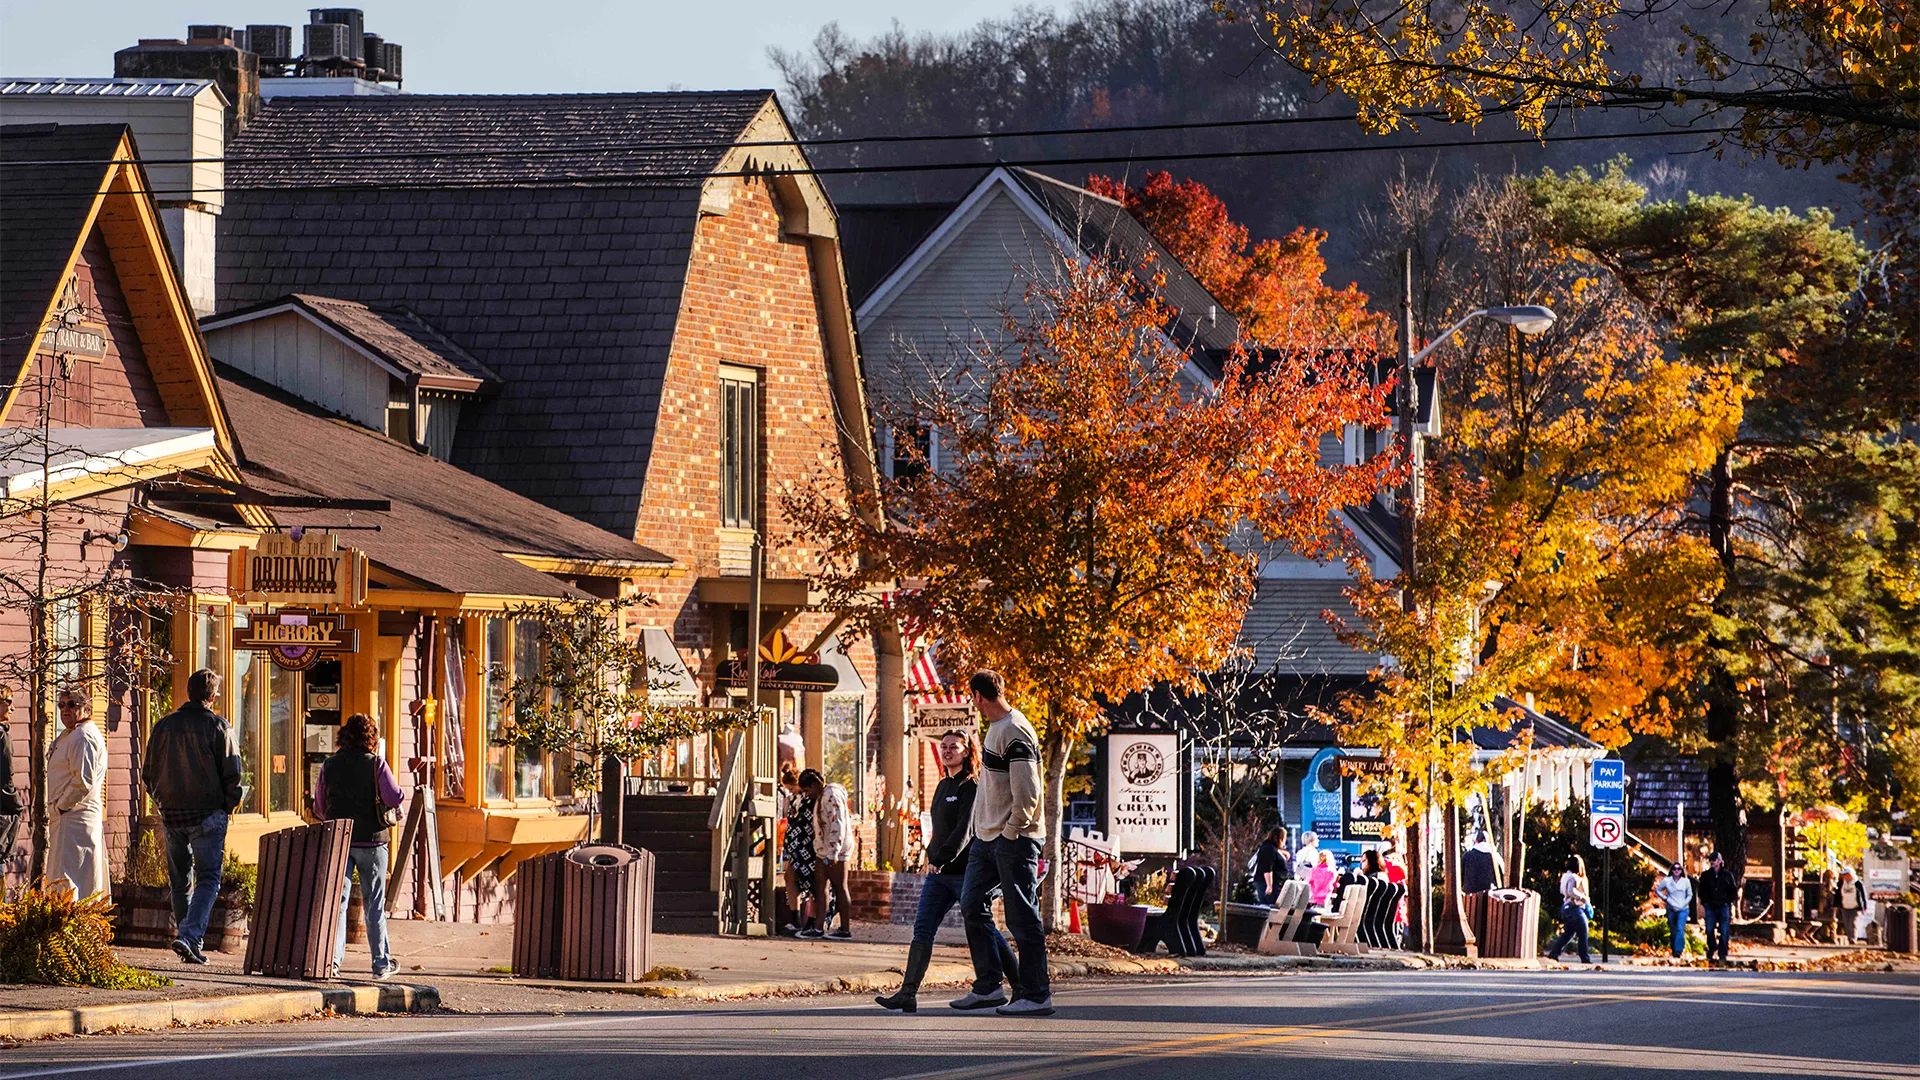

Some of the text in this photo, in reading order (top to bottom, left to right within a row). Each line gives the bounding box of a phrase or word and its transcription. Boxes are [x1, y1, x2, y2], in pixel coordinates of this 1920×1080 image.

[41, 327, 79, 348] ESTAURANT
[86, 333, 101, 352] BAR
[267, 542, 325, 555] OUT OF THE
[252, 556, 340, 594] ORDINARY
[253, 621, 334, 641] HICKORY
[272, 647, 315, 666] SPORTS BAR
[760, 682, 806, 691] HANDCRAFTED
[1599, 767, 1617, 777] PAY
[1593, 780, 1623, 789] PARKING
[1131, 795, 1154, 803] ICE
[1116, 803, 1167, 812] CREAM
[1115, 817, 1170, 826] YOGURT
